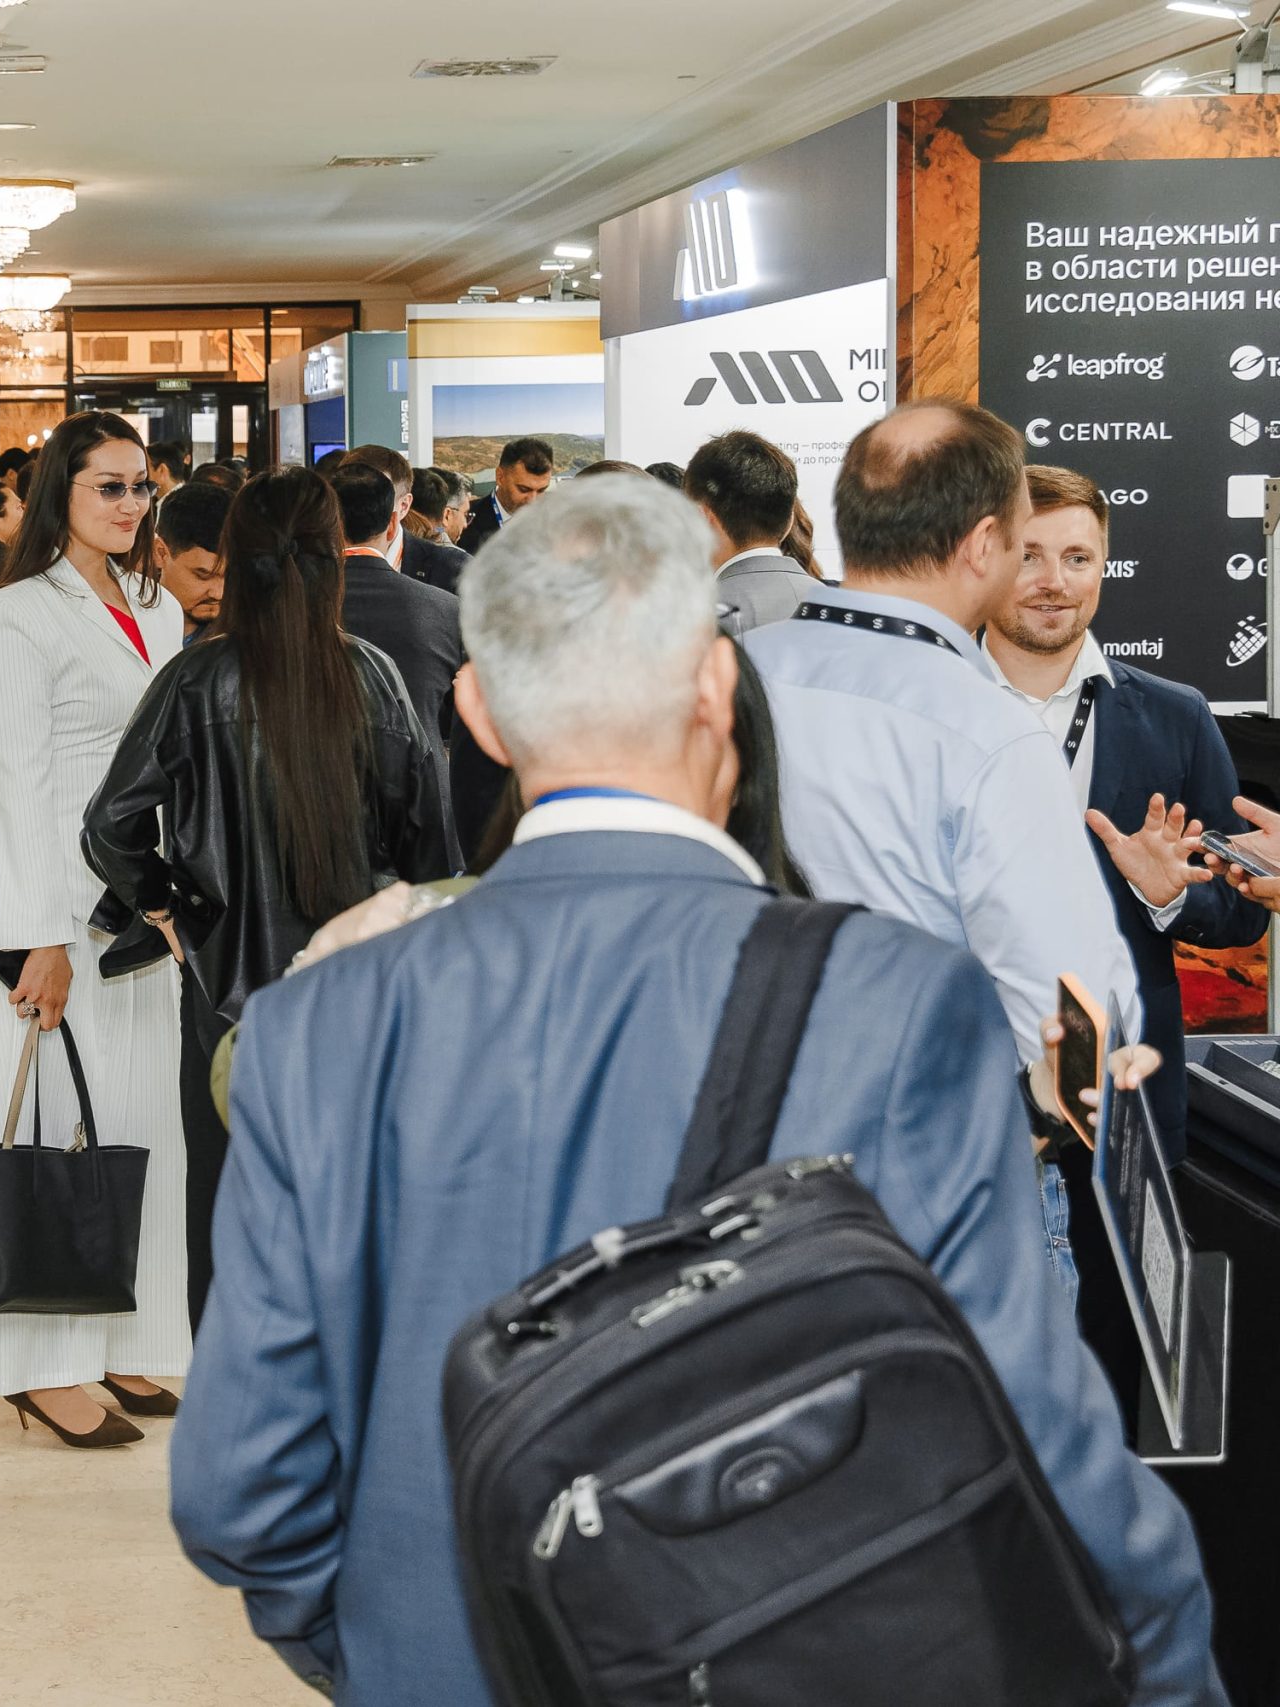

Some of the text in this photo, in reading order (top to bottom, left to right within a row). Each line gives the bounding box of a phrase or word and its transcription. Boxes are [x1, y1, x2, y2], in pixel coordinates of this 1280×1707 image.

[1025, 222, 1089, 248] Ваш
[1099, 217, 1260, 250] надежный
[1025, 261, 1043, 281] в
[1051, 254, 1177, 281] области
[1025, 290, 1246, 316] исследования
[849, 349, 886, 370] MI
[1067, 352, 1167, 380] leapfrog
[858, 380, 886, 402] O
[1059, 421, 1173, 441] CENTRAL
[1103, 637, 1163, 660] montaj
